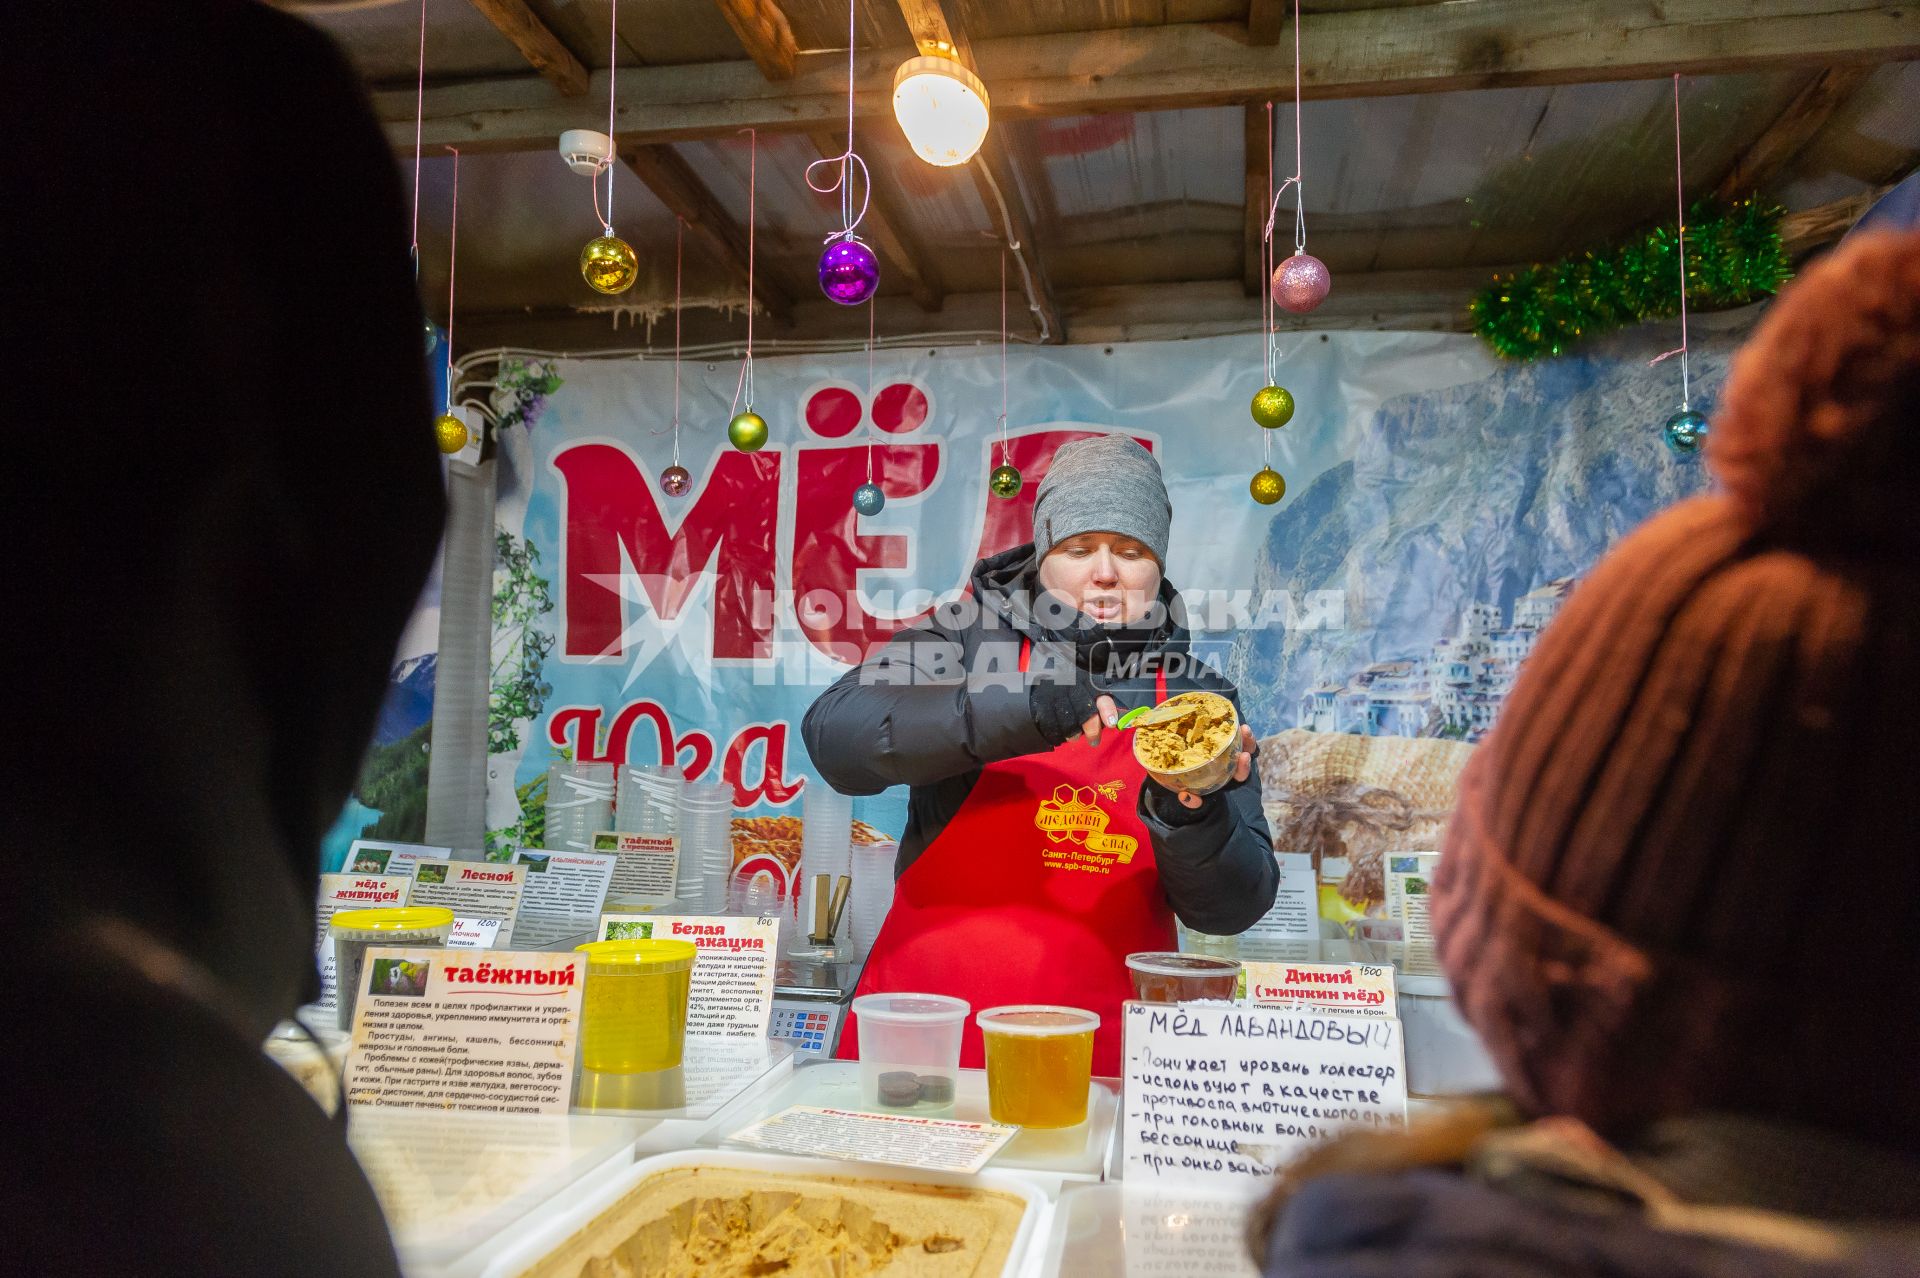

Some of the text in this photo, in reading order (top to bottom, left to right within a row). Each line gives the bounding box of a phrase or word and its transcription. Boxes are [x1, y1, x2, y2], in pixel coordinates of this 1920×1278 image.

[1042, 848, 1115, 865] Санкт-Петербург
[1044, 860, 1110, 874] www.spb-expo.ru
[461, 869, 514, 882] Лесной
[355, 880, 378, 889] мёд
[336, 889, 399, 902] живицей
[757, 916, 772, 927] 800
[672, 922, 725, 935] Белая
[695, 937, 764, 952] акация
[444, 962, 576, 986] таёжный
[1285, 968, 1353, 984] Дикий
[1359, 965, 1382, 977] 1500
